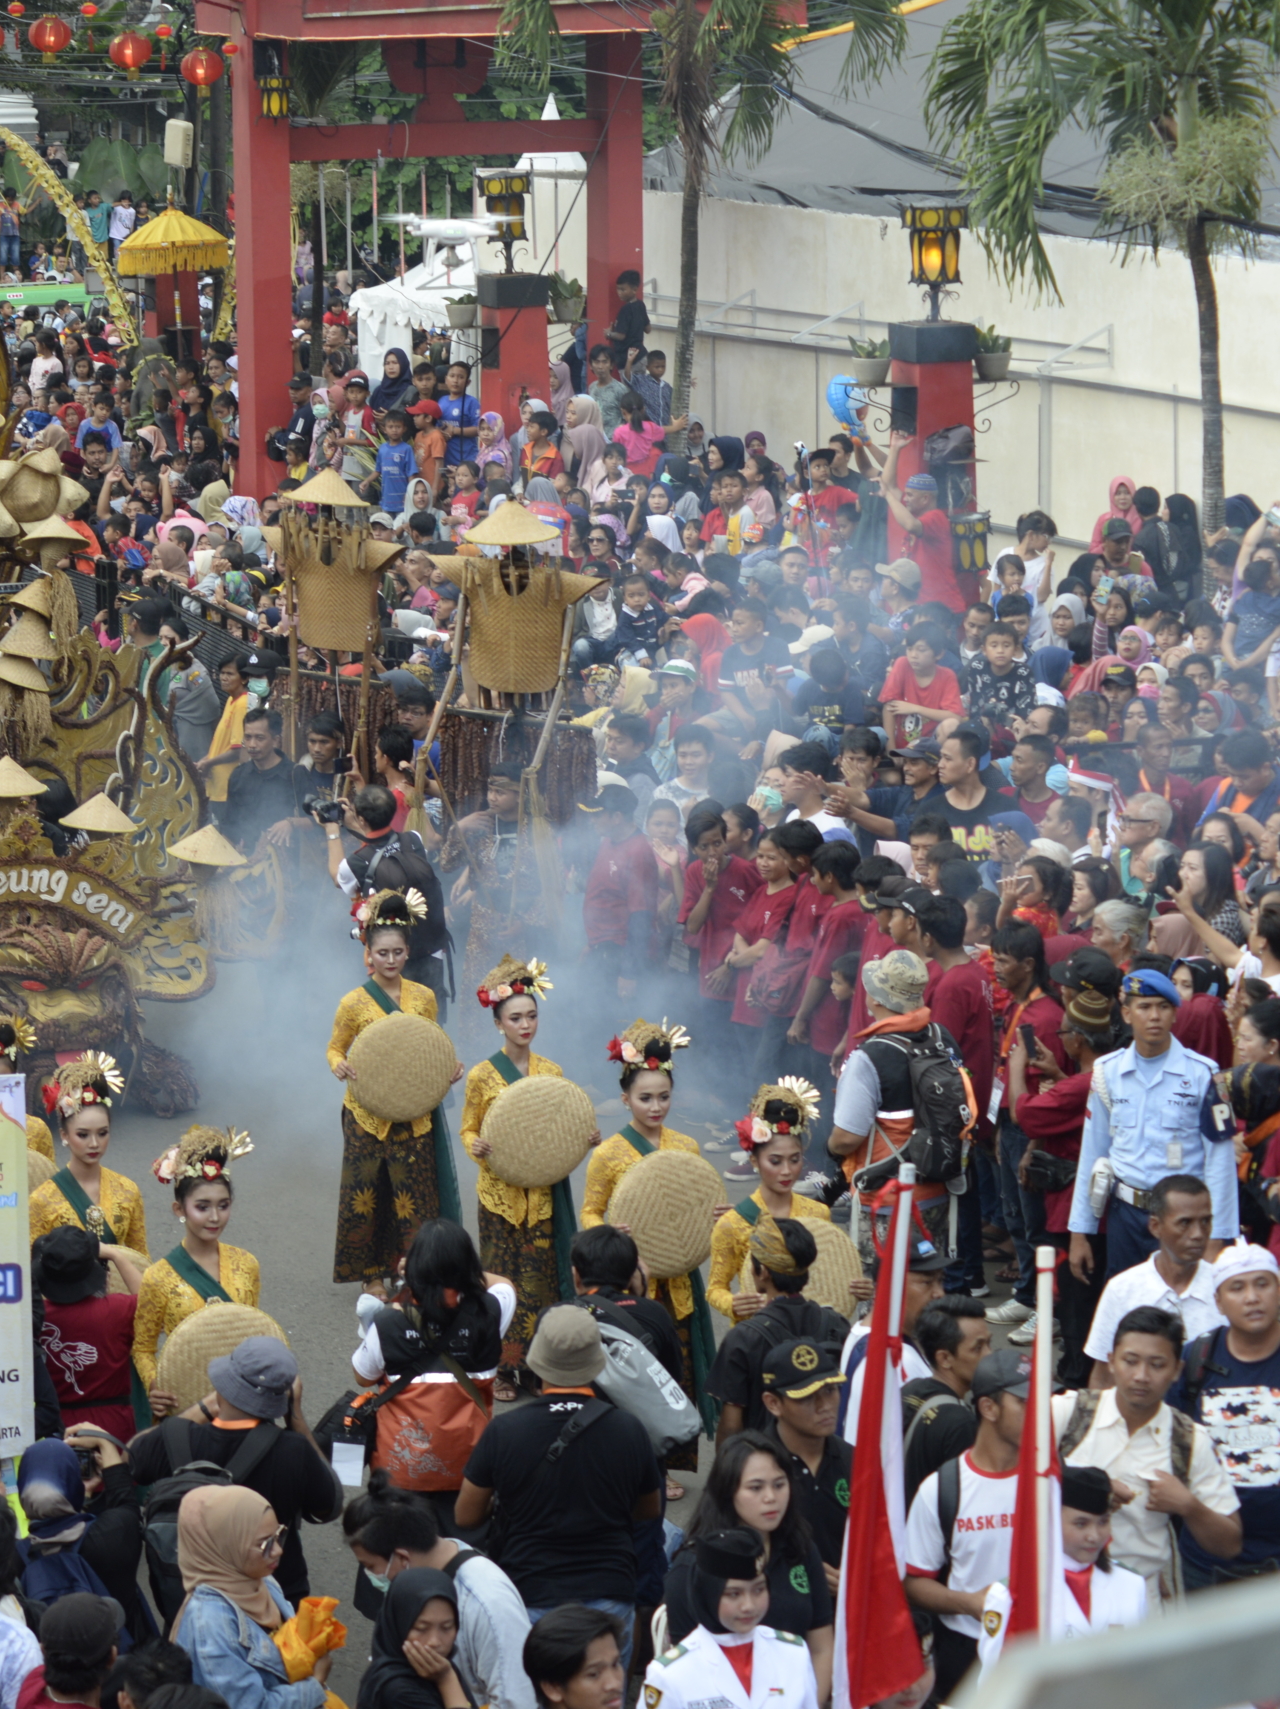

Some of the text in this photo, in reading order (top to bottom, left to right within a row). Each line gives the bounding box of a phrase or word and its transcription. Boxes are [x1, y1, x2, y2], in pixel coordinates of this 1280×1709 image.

[1167, 1099, 1184, 1107] TNI
[1212, 1103, 1230, 1132] P
[669, 1386, 685, 1405] 10
